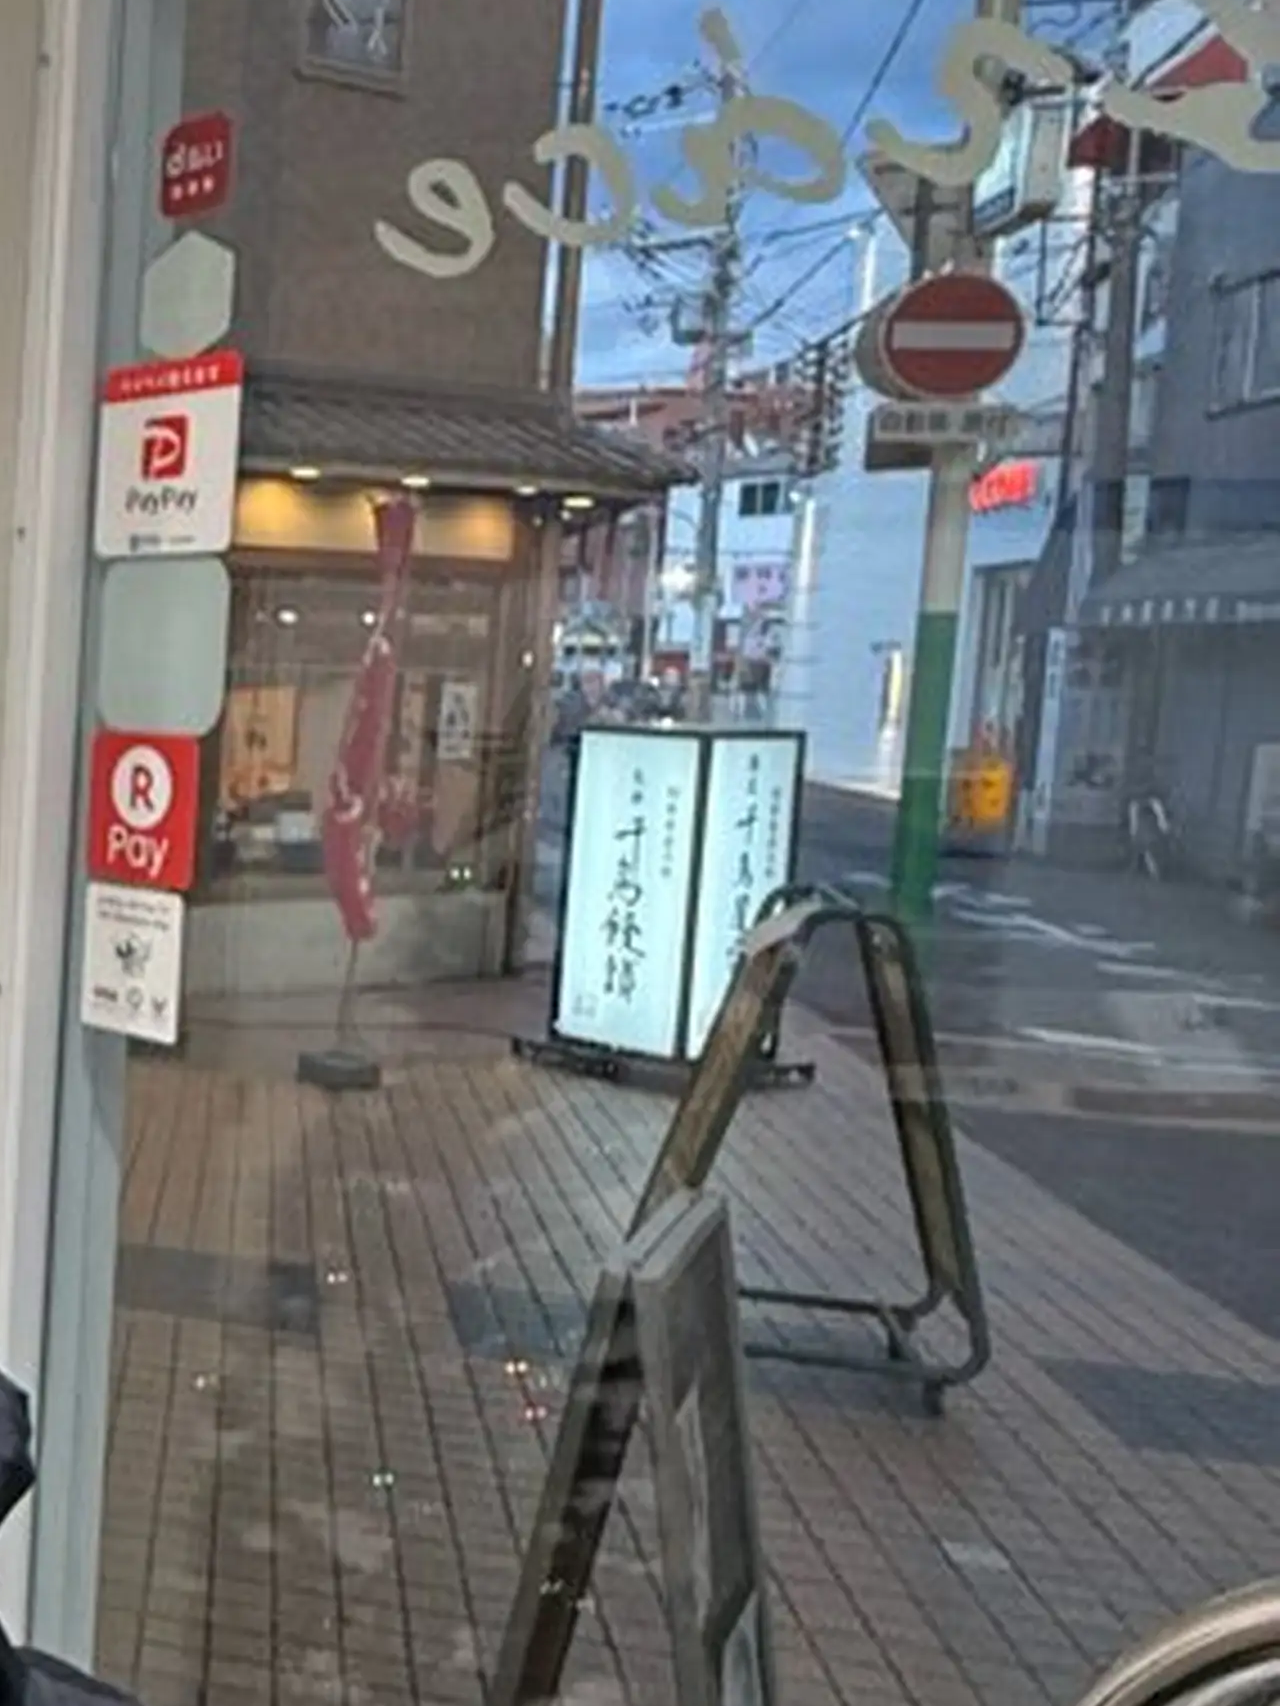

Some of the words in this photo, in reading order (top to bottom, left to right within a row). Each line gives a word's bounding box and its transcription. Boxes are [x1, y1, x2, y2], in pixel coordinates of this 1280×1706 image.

[125, 486, 199, 515] PayPay
[129, 764, 155, 811] R
[107, 824, 169, 877] Pay
